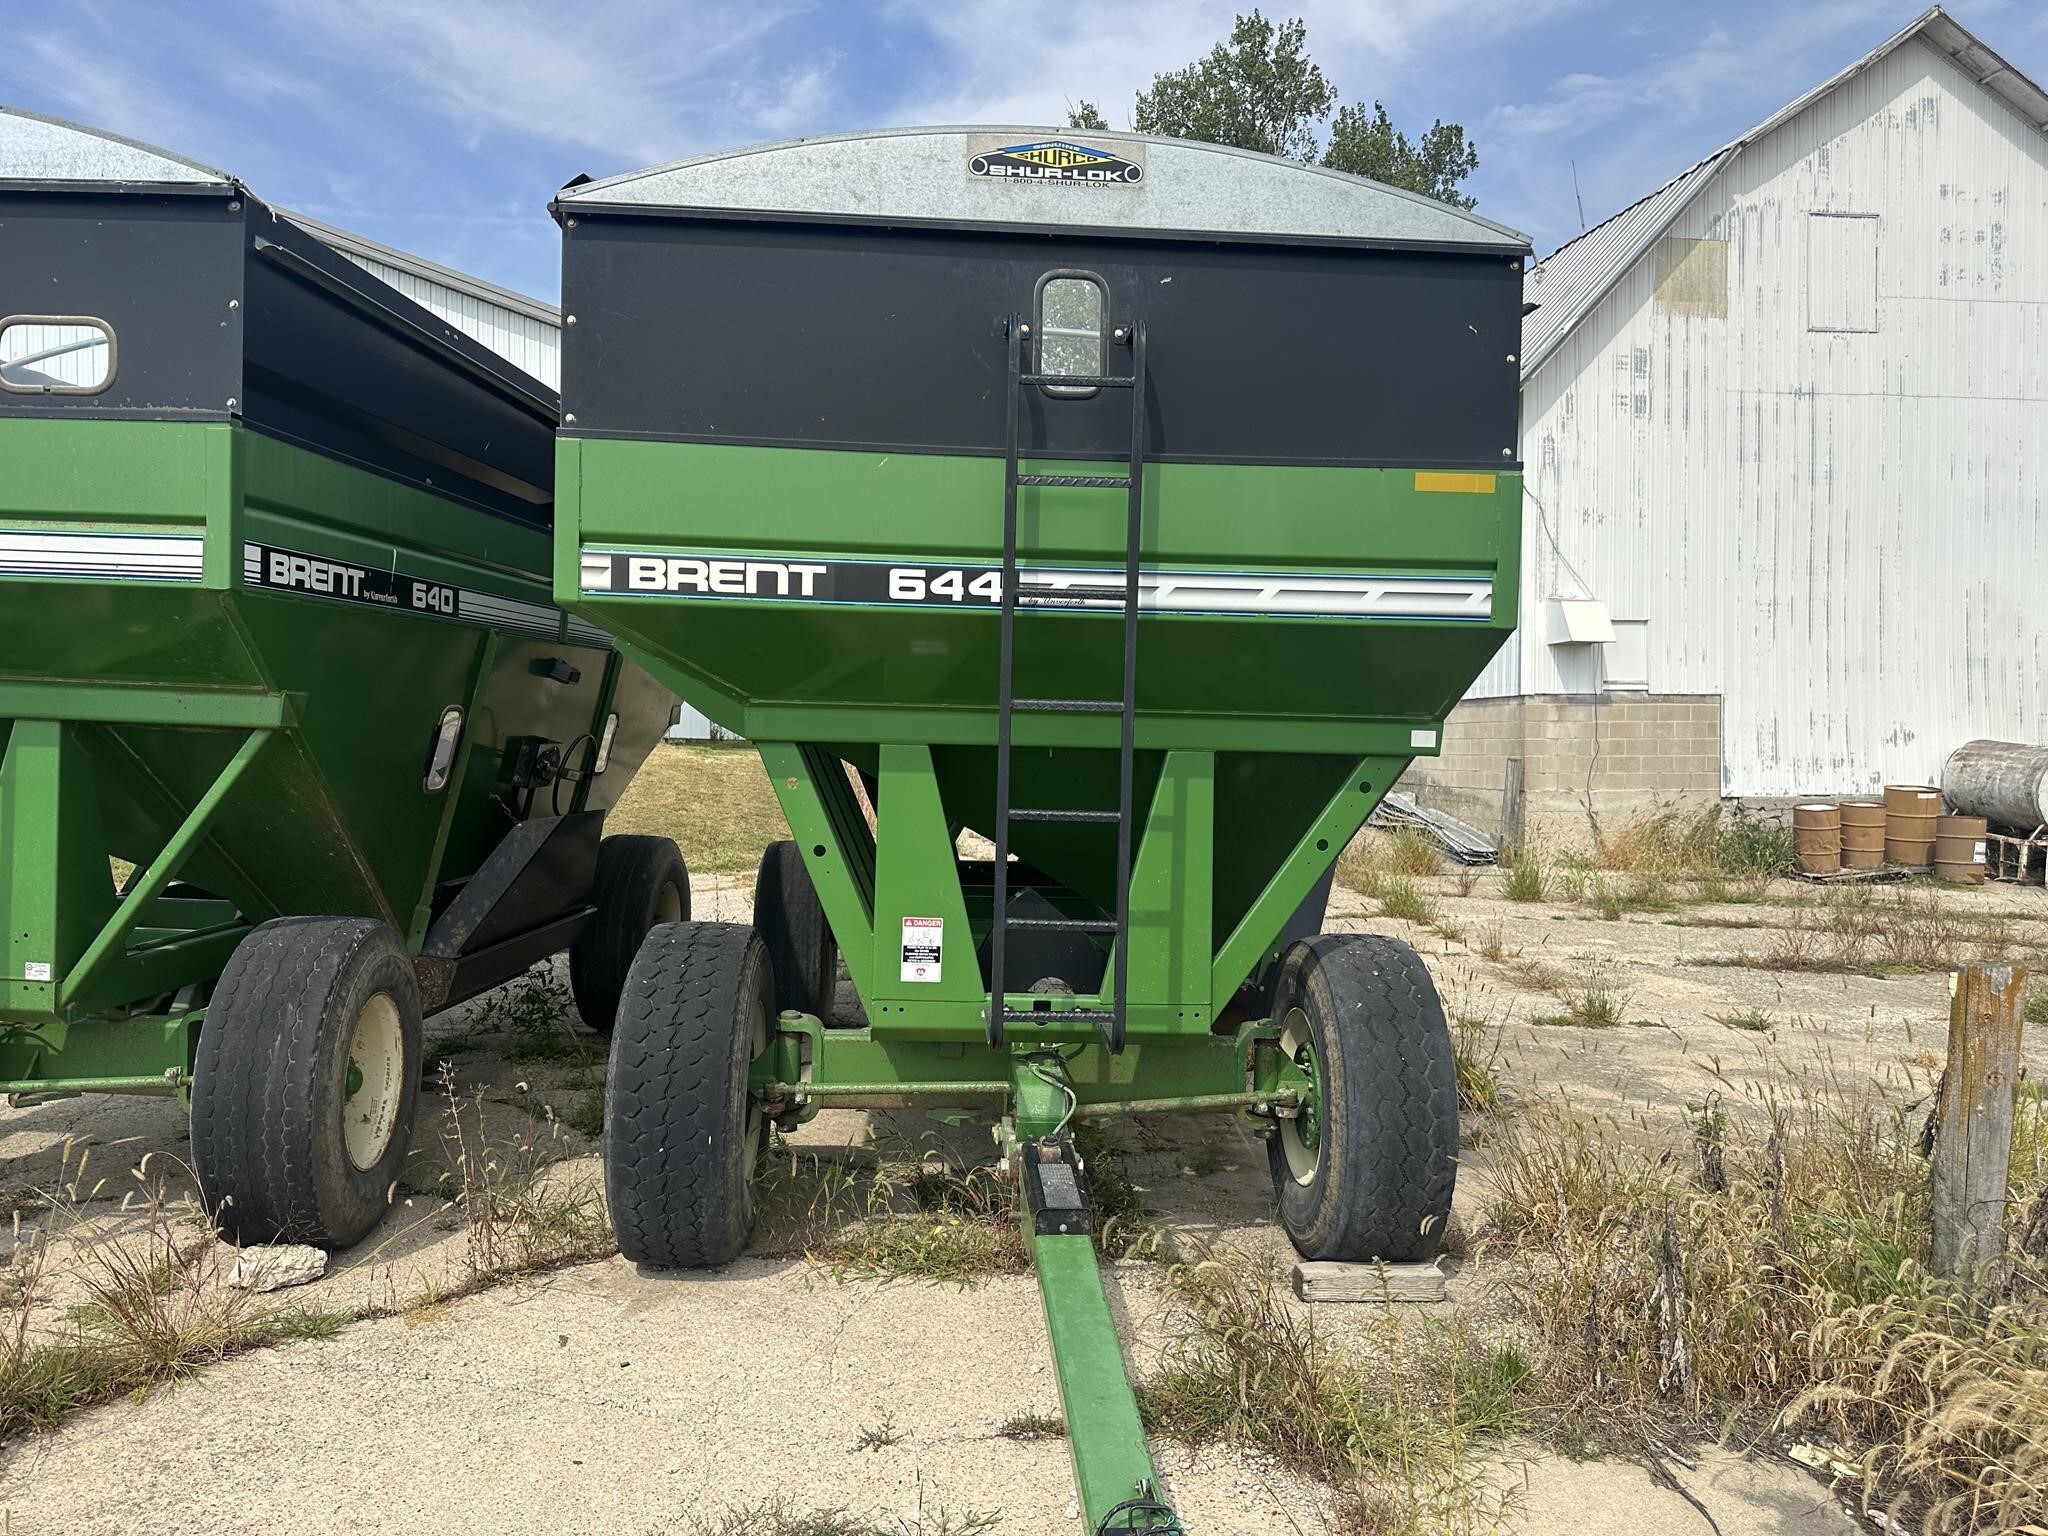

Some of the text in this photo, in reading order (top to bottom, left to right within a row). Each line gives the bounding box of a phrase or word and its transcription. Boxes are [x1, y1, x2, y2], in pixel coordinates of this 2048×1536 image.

[1032, 142, 1080, 151] GENUINE
[1017, 149, 1099, 166] SHURCO
[989, 165, 1124, 182] SHUR-LOK
[1003, 177, 1111, 189] 1-800-4-SHUR-LOK
[269, 552, 454, 613] BRENT 640
[628, 557, 1003, 603] BRENT 644
[913, 919, 942, 927] DANGER
